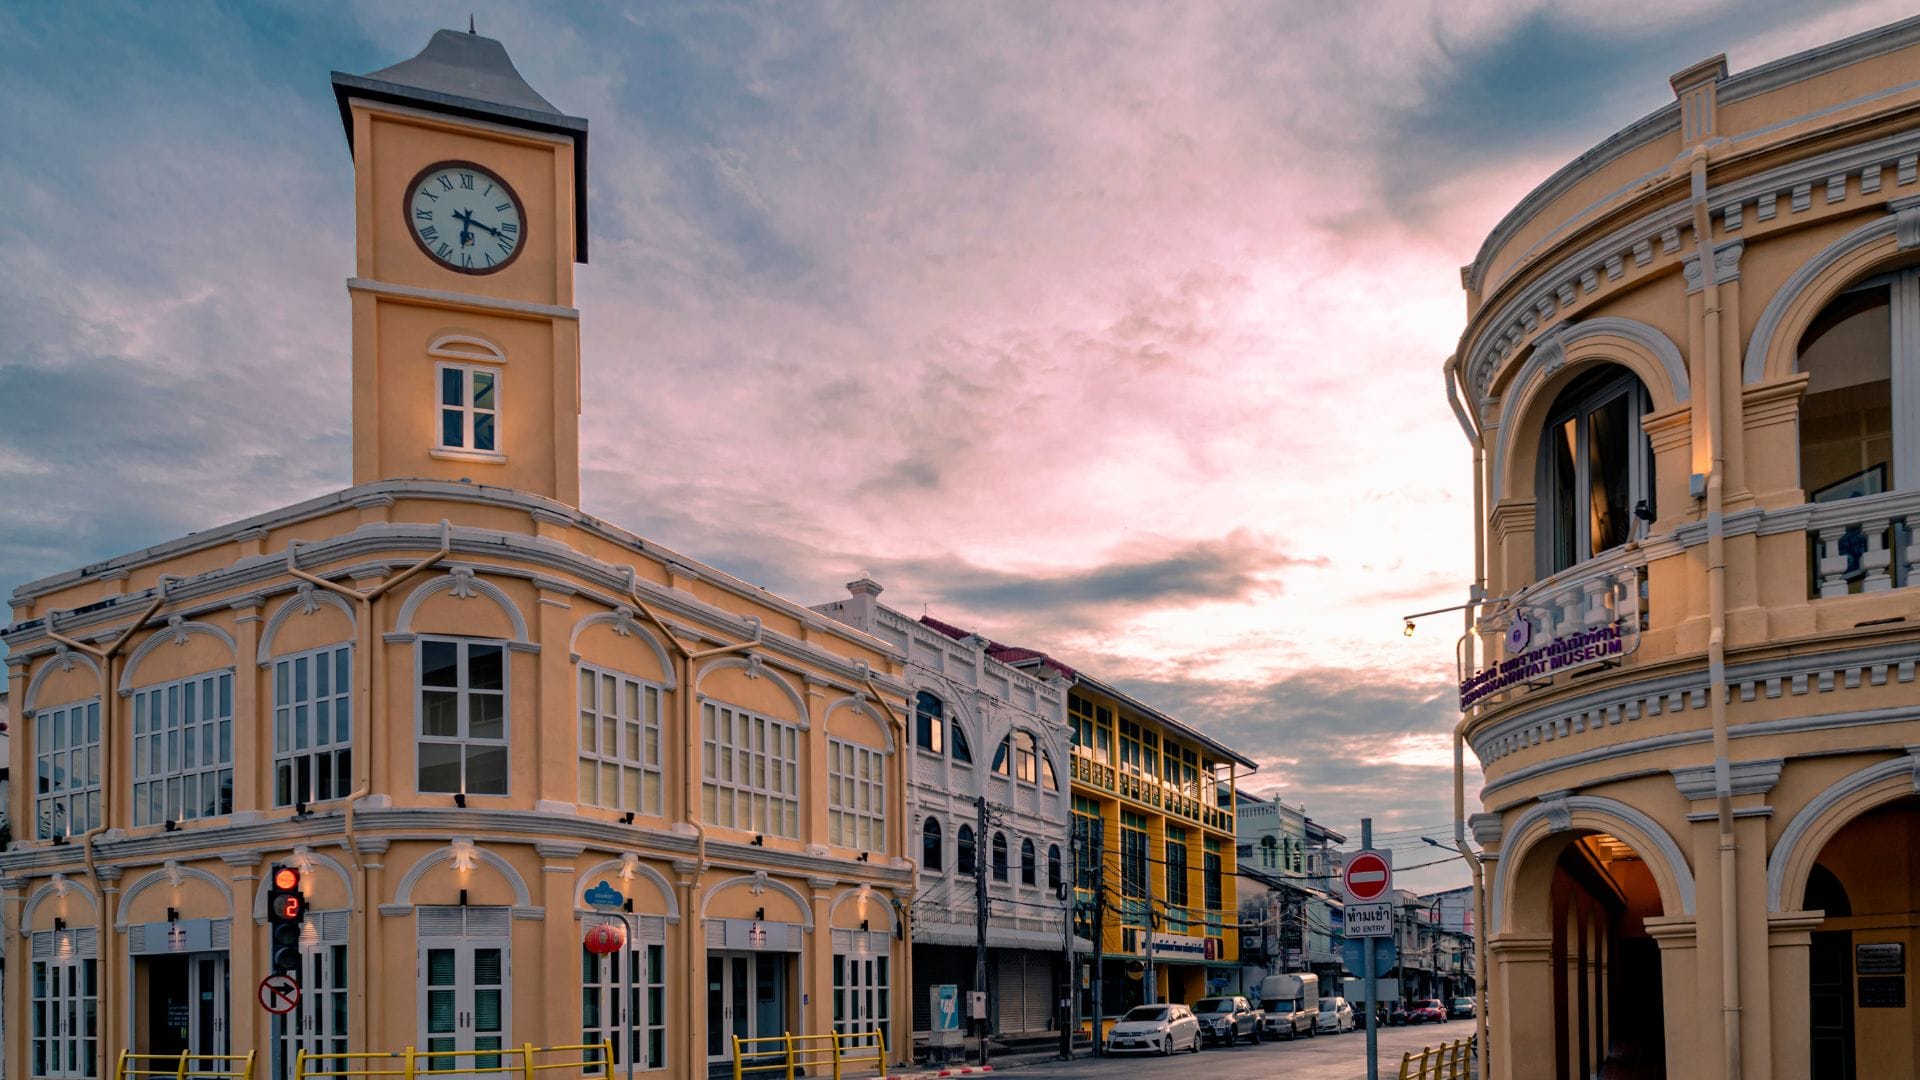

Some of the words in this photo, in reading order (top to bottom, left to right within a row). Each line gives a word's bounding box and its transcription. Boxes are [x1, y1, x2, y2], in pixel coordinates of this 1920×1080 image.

[436, 175, 454, 192] XI
[459, 173, 474, 191] XII
[421, 188, 438, 202] X
[496, 203, 511, 212] II
[502, 223, 517, 233] III
[1550, 639, 1622, 670] MUSEUM
[287, 898, 297, 916] 2
[1347, 906, 1389, 922] ห้ามเข้า
